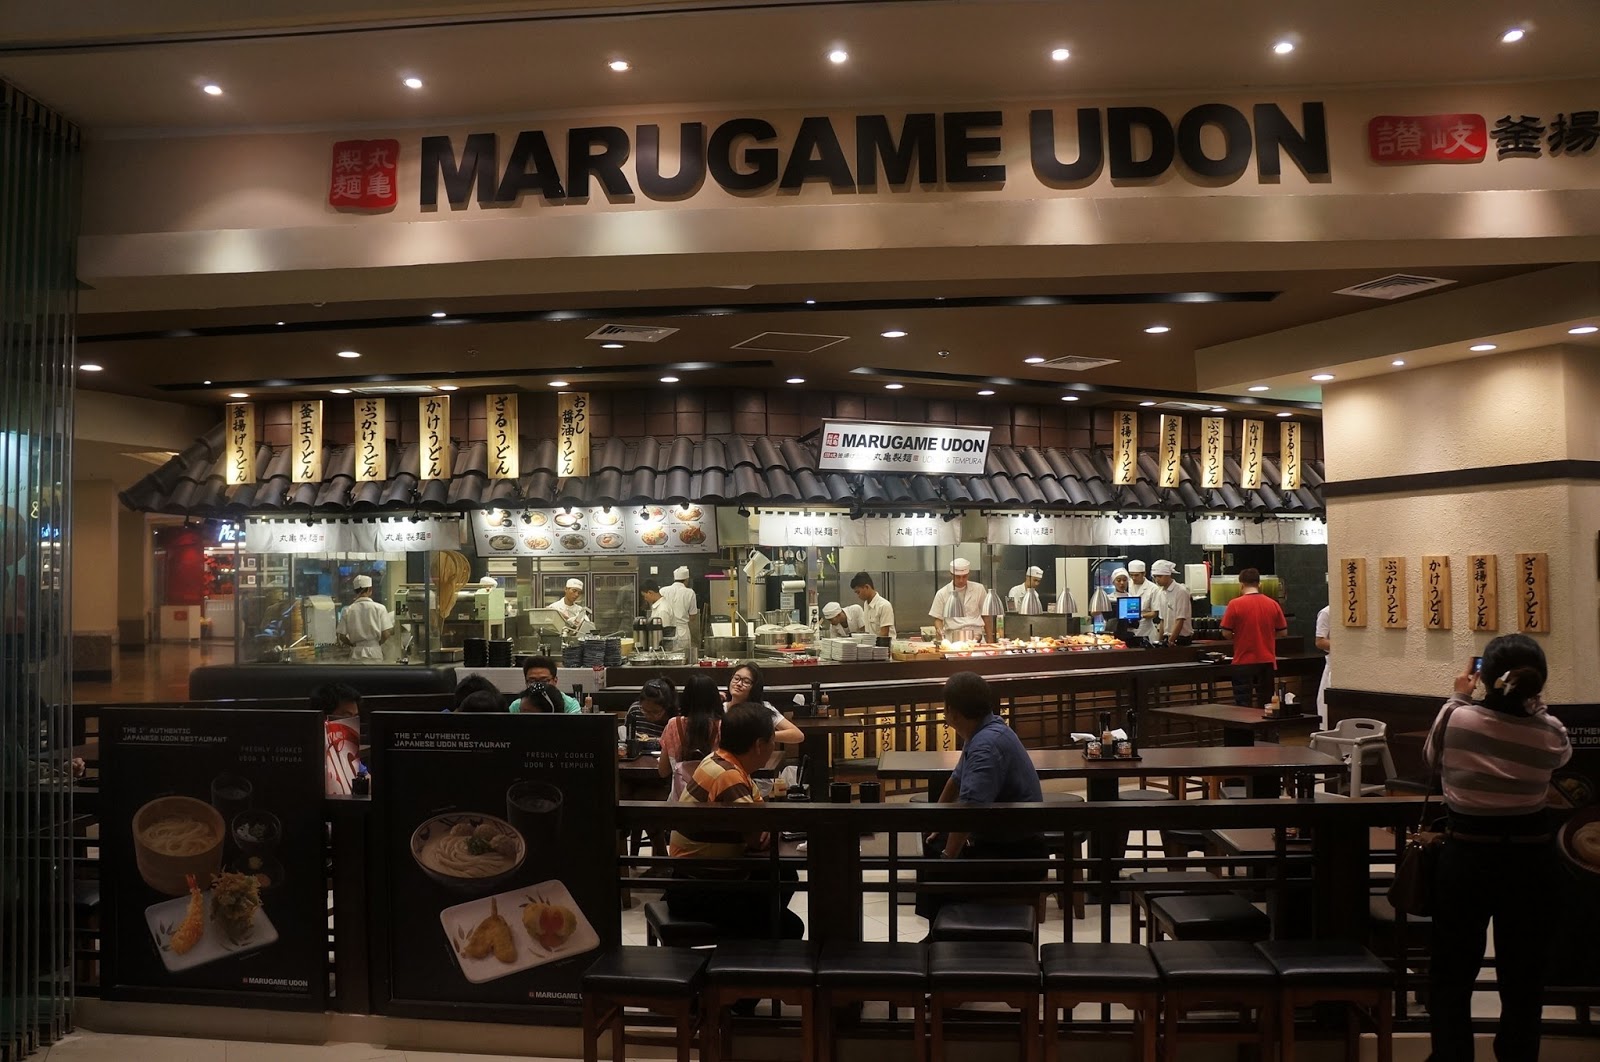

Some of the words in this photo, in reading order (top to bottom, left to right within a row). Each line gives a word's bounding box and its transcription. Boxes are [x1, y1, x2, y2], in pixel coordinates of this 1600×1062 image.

[420, 110, 1005, 211] MARUGAME
[1030, 101, 1331, 188] UDON
[232, 405, 248, 482] 釜揚げうどん
[299, 403, 315, 479] 釜玉うどん
[360, 401, 378, 477] ぶっかけうどん
[426, 399, 442, 477] かけうどん
[573, 395, 586, 434] おろし
[842, 433, 938, 451] MARUGAME
[941, 438, 985, 453] UDON
[952, 456, 984, 466] TEMPURA
[1166, 418, 1178, 485] 釜玉うどん
[1207, 420, 1220, 485] ぶっかけうどん
[1248, 422, 1259, 487] かけうどん
[1347, 561, 1358, 624] 釜玉うどん
[1385, 560, 1398, 624] ぶっかけうどん
[1428, 559, 1441, 626] かけうどん
[1474, 557, 1488, 628] 釜揚げうどん
[180, 735, 228, 743] RESTAURANT
[394, 732, 410, 740] THE
[424, 733, 471, 741] AUTHENTIC
[394, 740, 435, 748] JAPANESE
[458, 741, 511, 749] RESTAURANT
[560, 761, 595, 769] TEMPURA
[248, 977, 288, 986] MARUGAME
[288, 979, 309, 987] UDON
[535, 991, 578, 1000] MARUGAME
